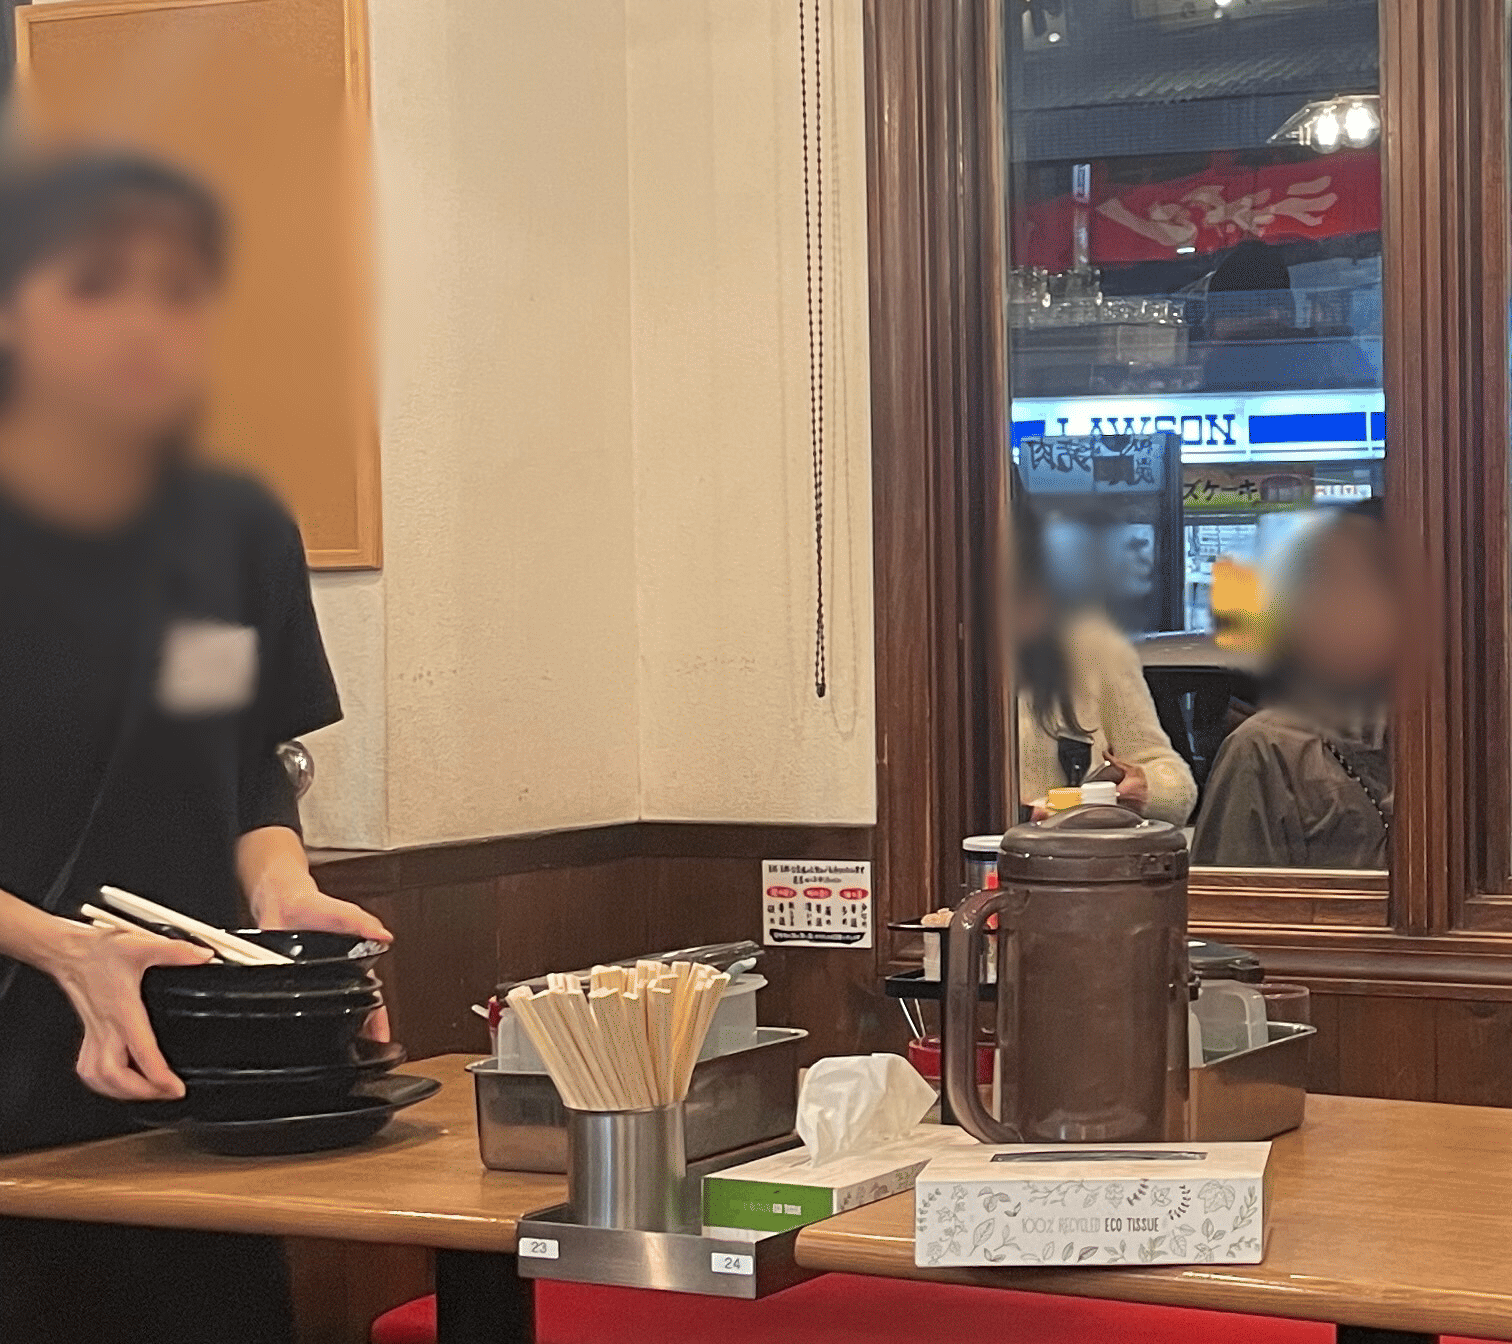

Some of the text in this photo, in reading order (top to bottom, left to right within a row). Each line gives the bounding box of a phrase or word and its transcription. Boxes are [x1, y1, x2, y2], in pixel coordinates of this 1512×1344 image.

[1057, 414, 1236, 447] LAWSON
[1105, 1217, 1122, 1232] ECO
[1127, 1217, 1160, 1232] TISSUE
[531, 1241, 547, 1254] 23
[724, 1257, 741, 1270] 24
